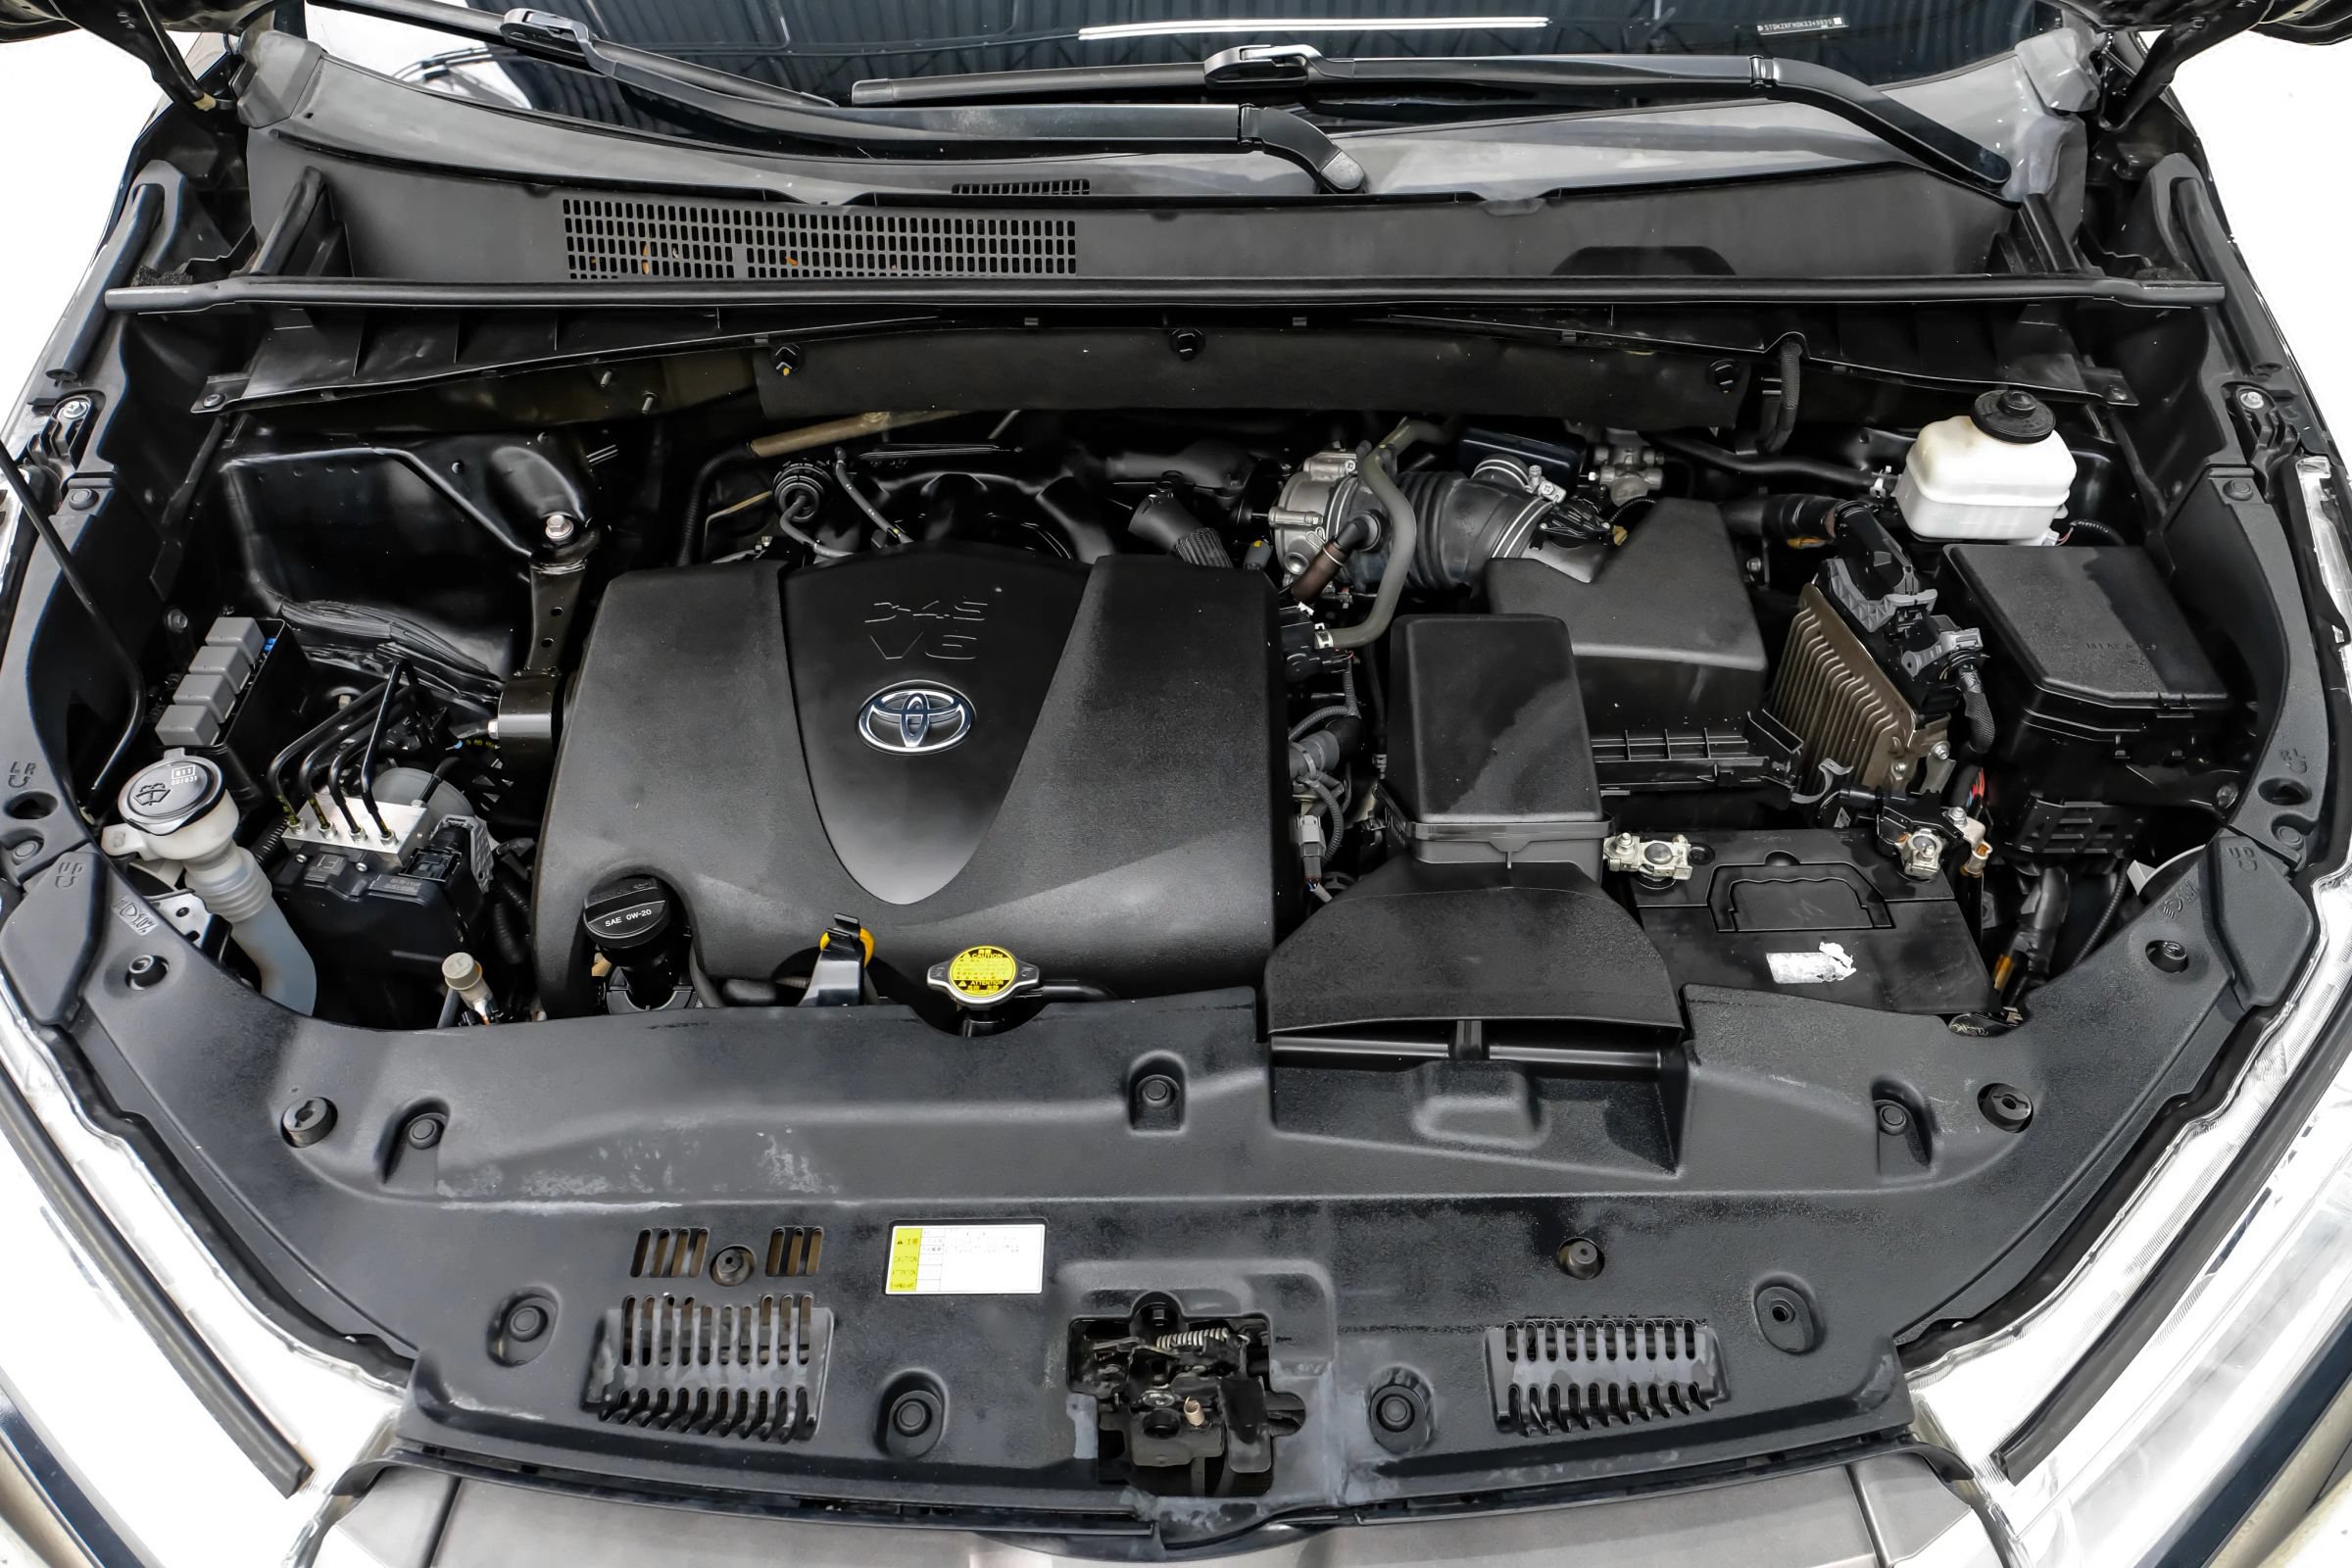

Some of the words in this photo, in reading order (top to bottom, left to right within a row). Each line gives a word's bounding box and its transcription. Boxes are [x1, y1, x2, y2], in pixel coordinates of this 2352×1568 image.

[24, 762, 36, 775] R
[58, 861, 84, 875] UP
[605, 916, 622, 927] SAE
[625, 908, 652, 921] 0W-20
